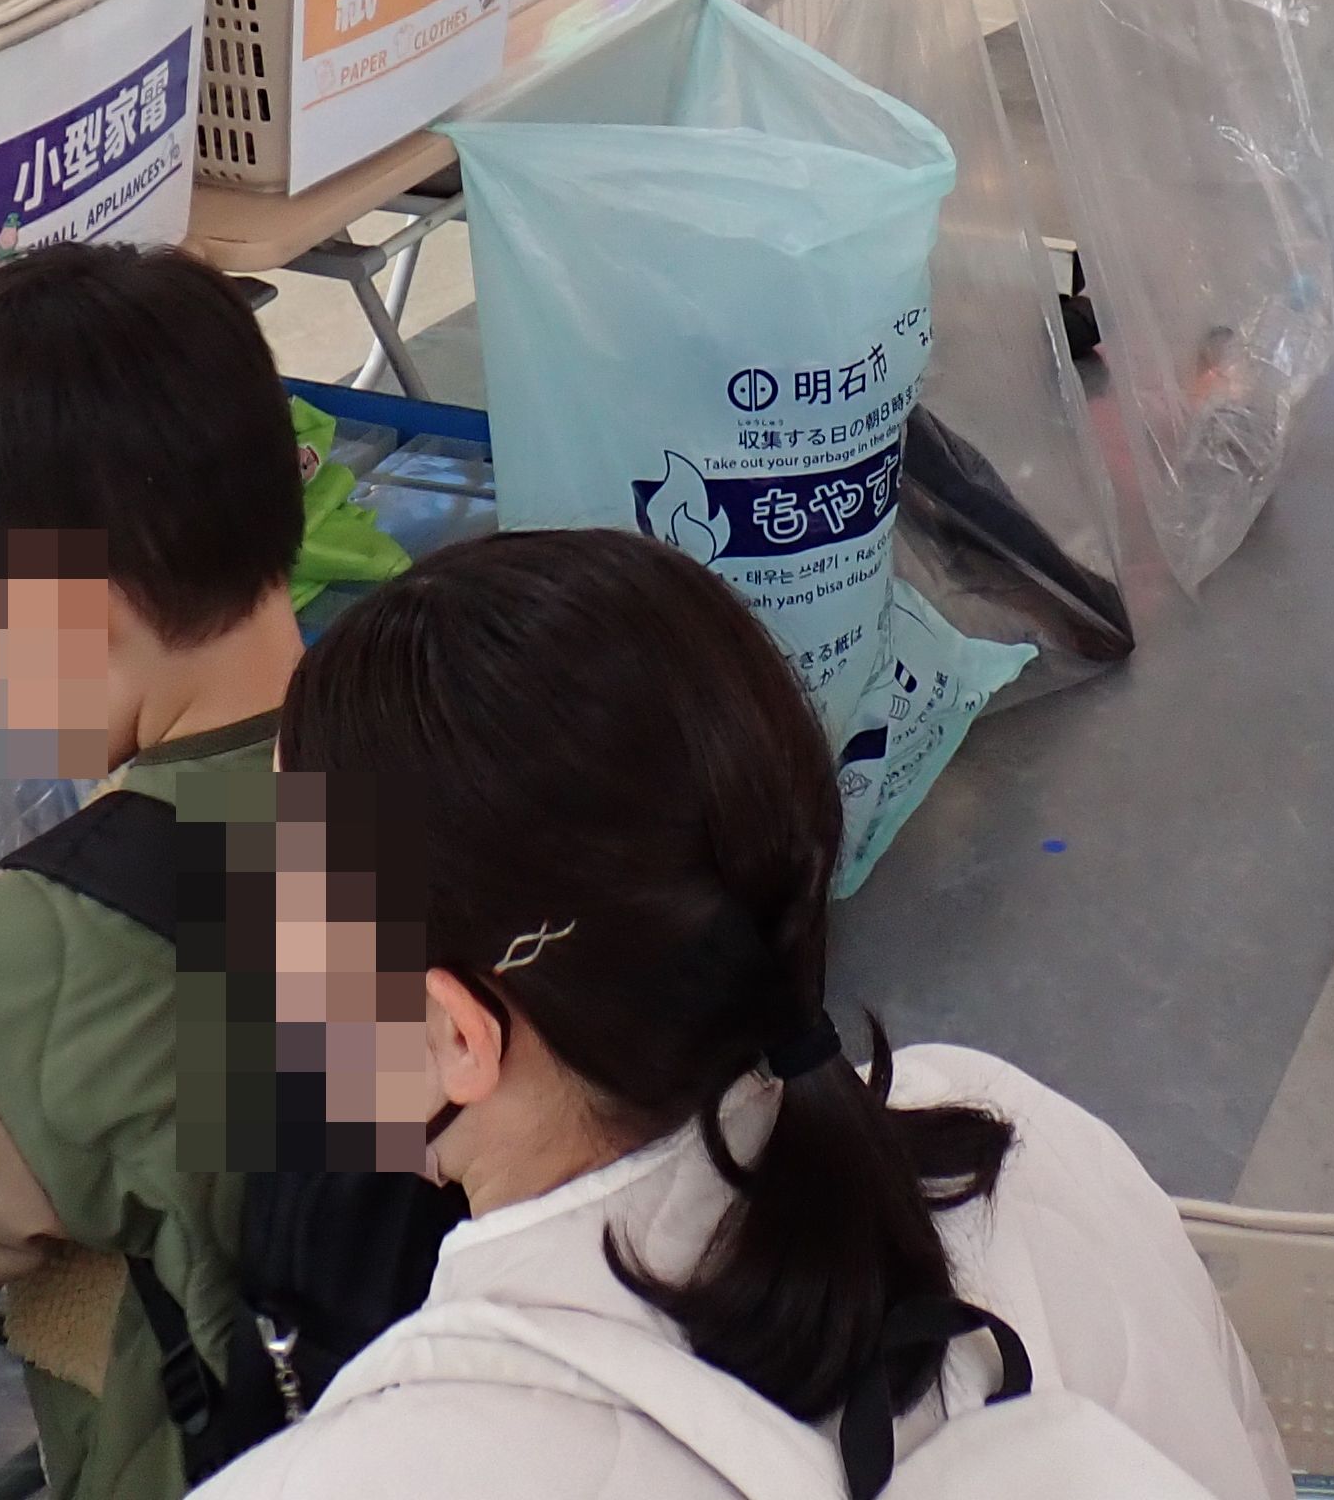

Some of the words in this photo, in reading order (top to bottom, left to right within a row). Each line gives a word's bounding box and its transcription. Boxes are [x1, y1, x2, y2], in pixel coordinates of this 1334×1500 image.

[339, 50, 388, 86] PAPER
[413, 6, 469, 51] CLOTHES
[13, 60, 170, 212] 小型家電
[86, 158, 163, 230] APPLIANCES
[794, 343, 889, 405] 明石市
[704, 457, 736, 470] Take
[740, 455, 764, 469] out
[767, 456, 799, 470] your
[802, 448, 856, 468] garbage
[857, 442, 868, 455] in
[869, 431, 886, 448] the
[746, 568, 795, 586] 태우는
[799, 553, 839, 580] 쓰레기
[776, 589, 815, 611] yang
[816, 580, 844, 598] bisa
